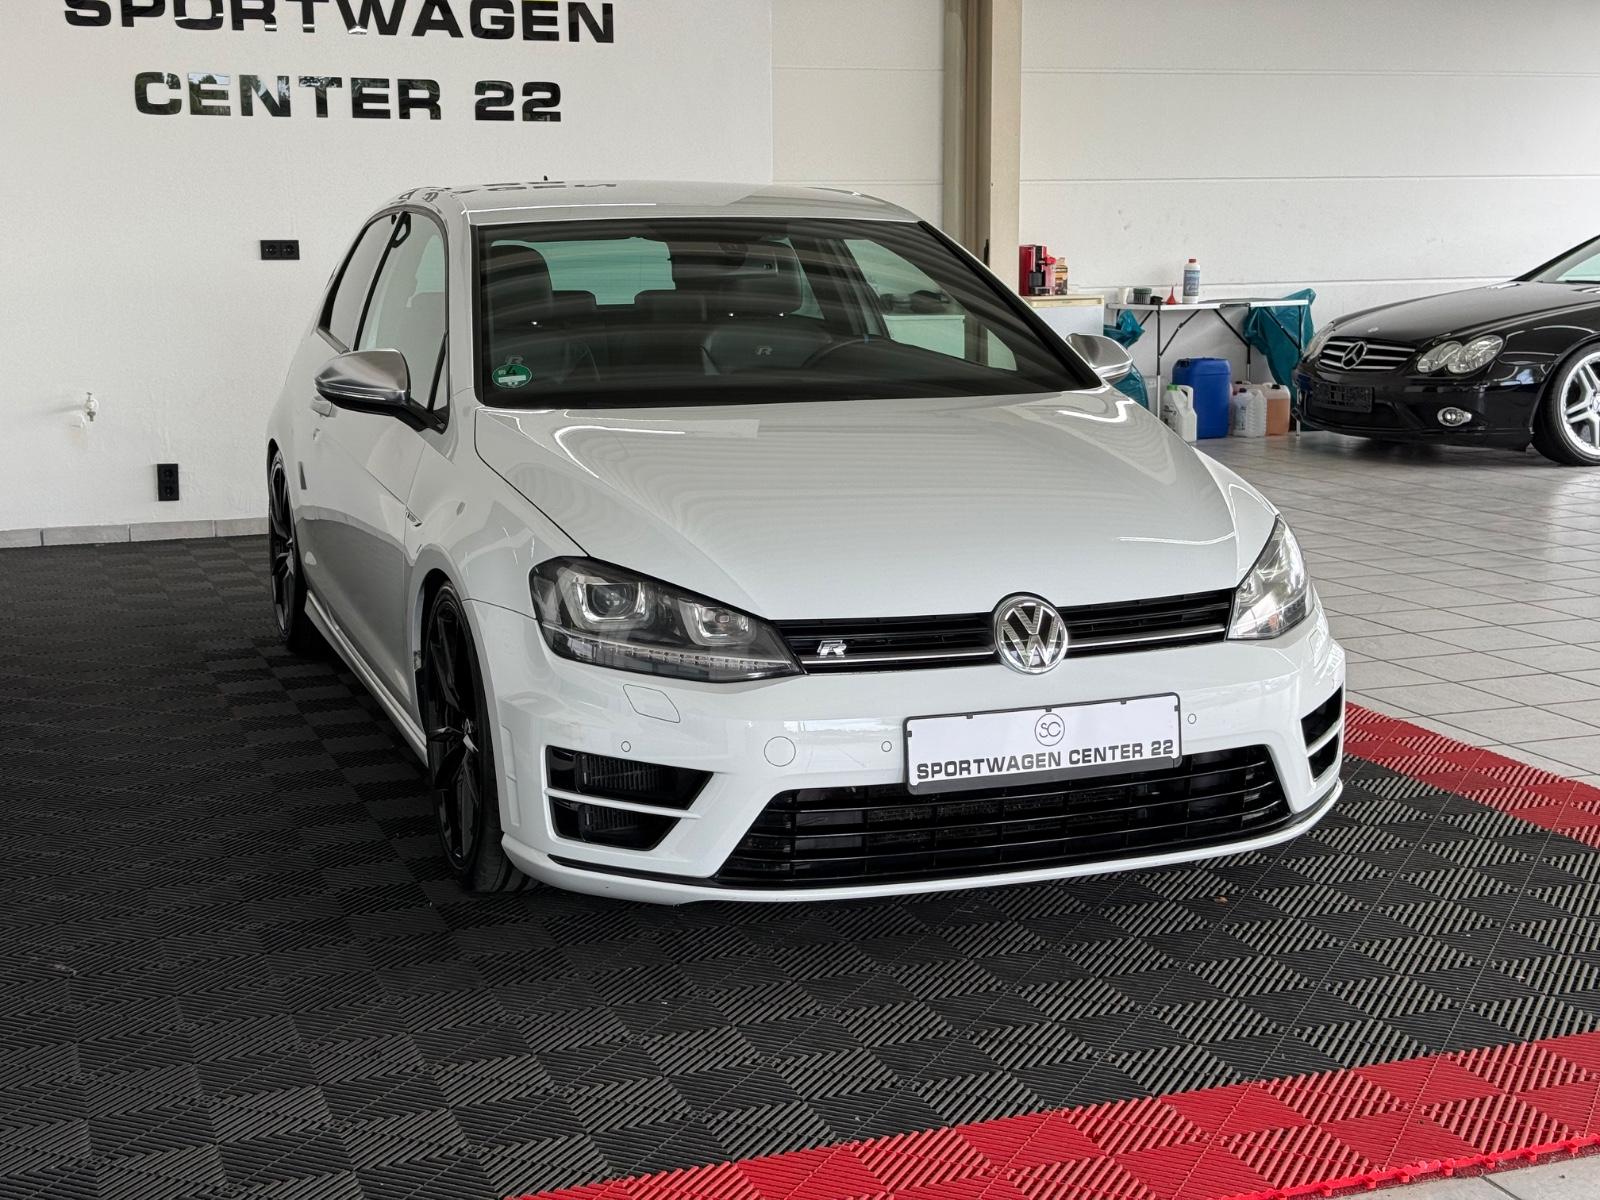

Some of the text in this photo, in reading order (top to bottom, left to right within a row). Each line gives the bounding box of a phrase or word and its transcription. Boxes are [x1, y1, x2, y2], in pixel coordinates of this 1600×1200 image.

[64, 0, 613, 43] SPORTWAGEN
[134, 71, 562, 122] CENTER 22
[816, 639, 847, 657] R
[1039, 721, 1062, 738] SC
[916, 739, 1174, 779] SPORTWAGEN CENTER 22
